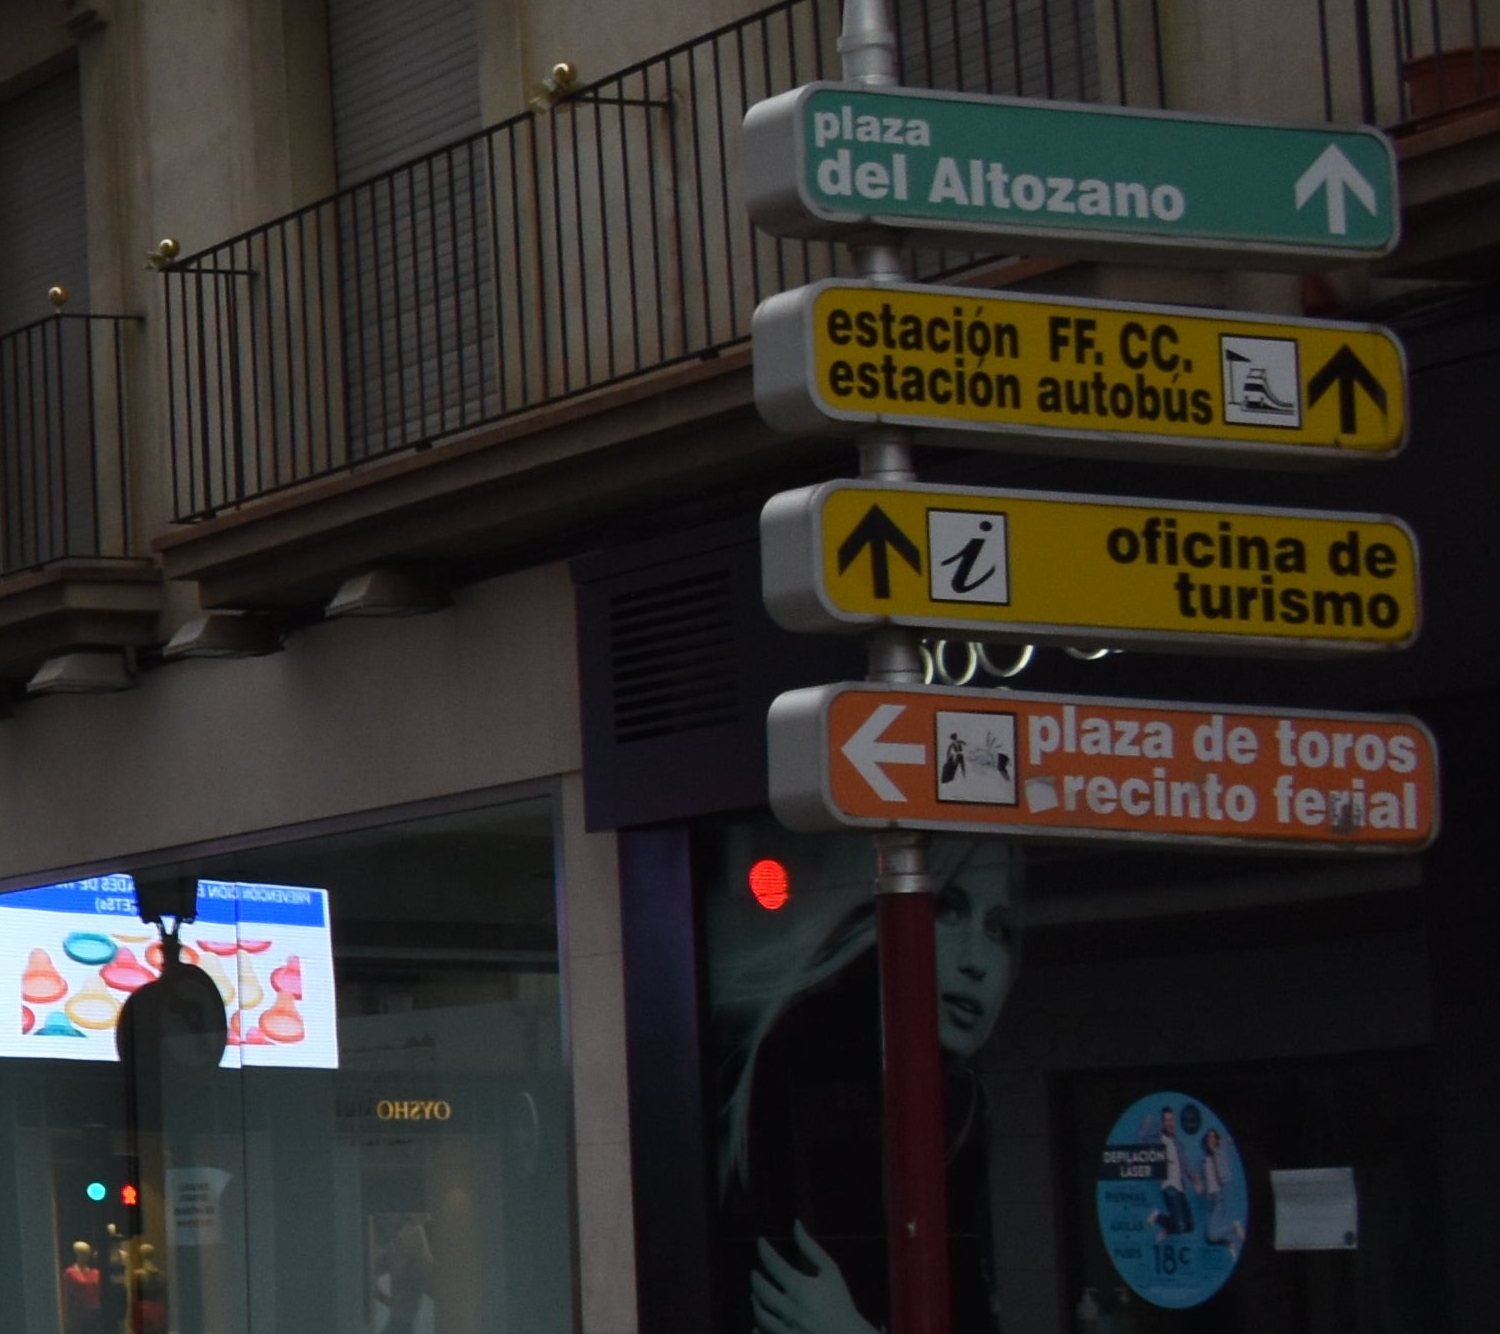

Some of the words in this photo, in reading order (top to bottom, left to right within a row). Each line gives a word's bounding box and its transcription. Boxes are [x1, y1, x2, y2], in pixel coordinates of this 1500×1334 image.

[813, 105, 931, 147] plaza
[817, 149, 908, 200] del
[929, 157, 1186, 222] Altozano
[827, 303, 1019, 358] estación
[1048, 316, 1103, 365] FF.
[1119, 322, 1193, 373] CC.
[829, 354, 1021, 409] estación
[1037, 371, 1214, 425] autobús
[1107, 518, 1307, 573] oficina
[1328, 530, 1397, 579] de
[1175, 571, 1400, 629] turismo
[1028, 705, 1174, 765] plaza
[1193, 715, 1259, 765] de
[1276, 720, 1418, 773] toros
[1064, 767, 1257, 823] recinto
[1274, 774, 1418, 830] ferial
